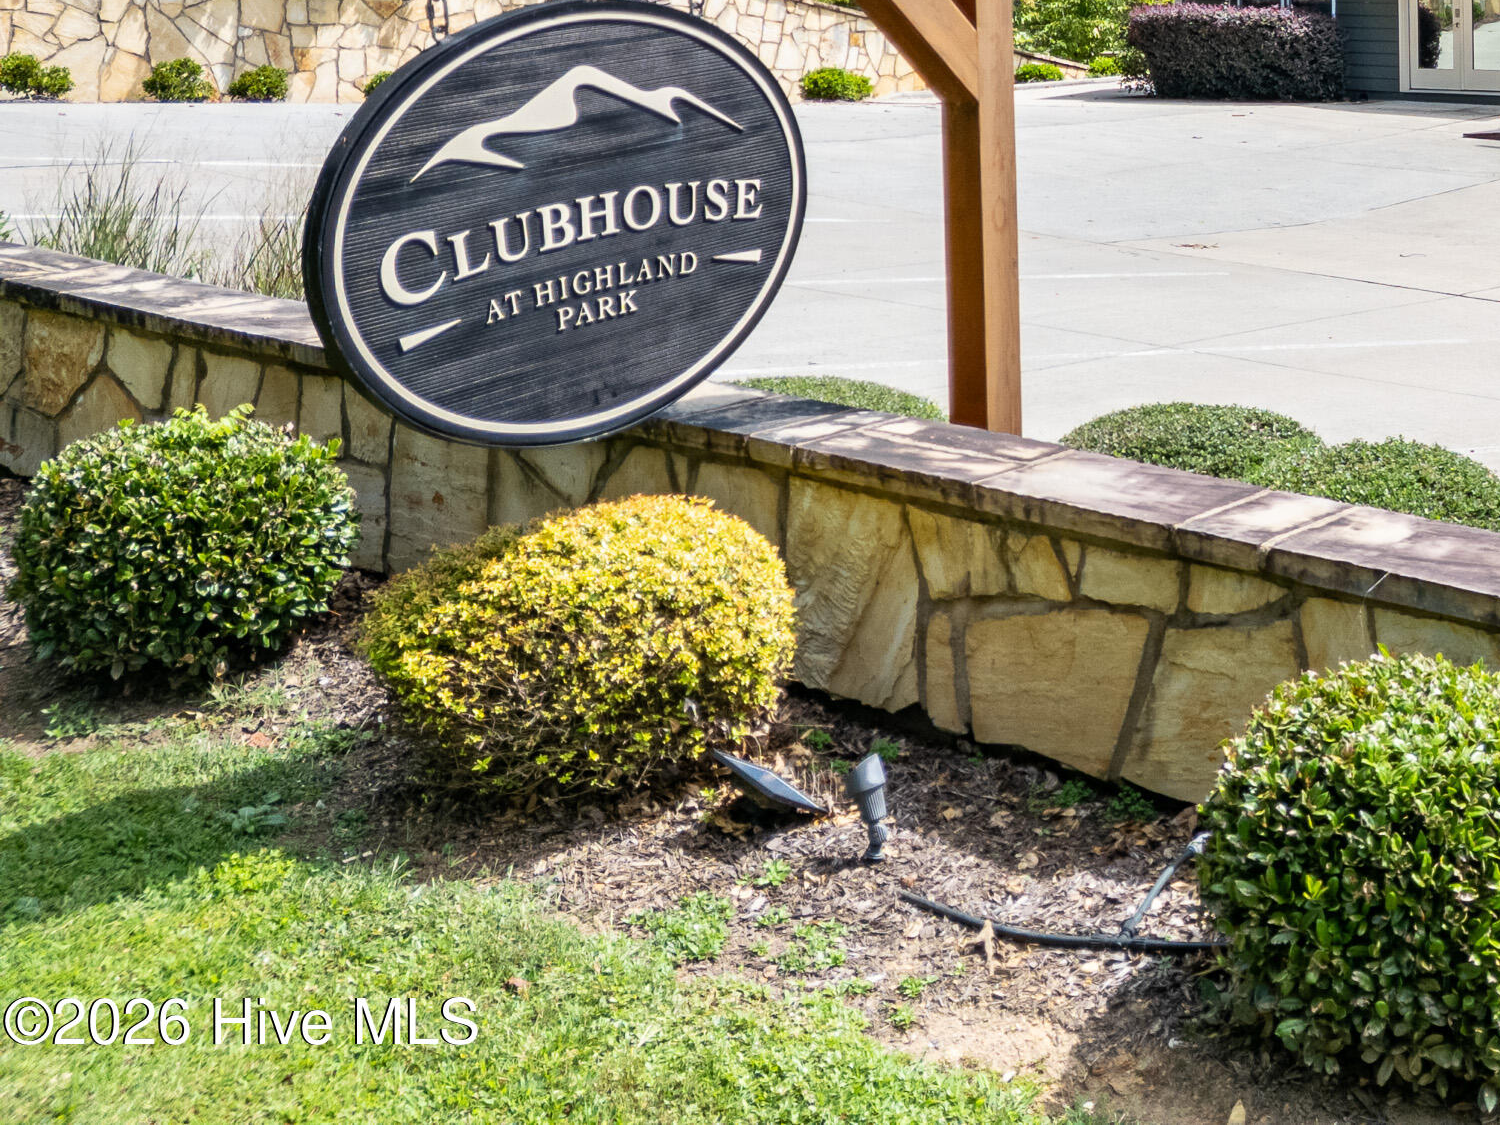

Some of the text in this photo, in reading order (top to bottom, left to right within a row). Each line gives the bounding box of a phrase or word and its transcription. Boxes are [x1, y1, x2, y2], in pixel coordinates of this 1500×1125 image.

[380, 179, 763, 305] CLUBHOUSE
[486, 251, 698, 324] AT HIGHLAND
[556, 290, 639, 331] PARK
